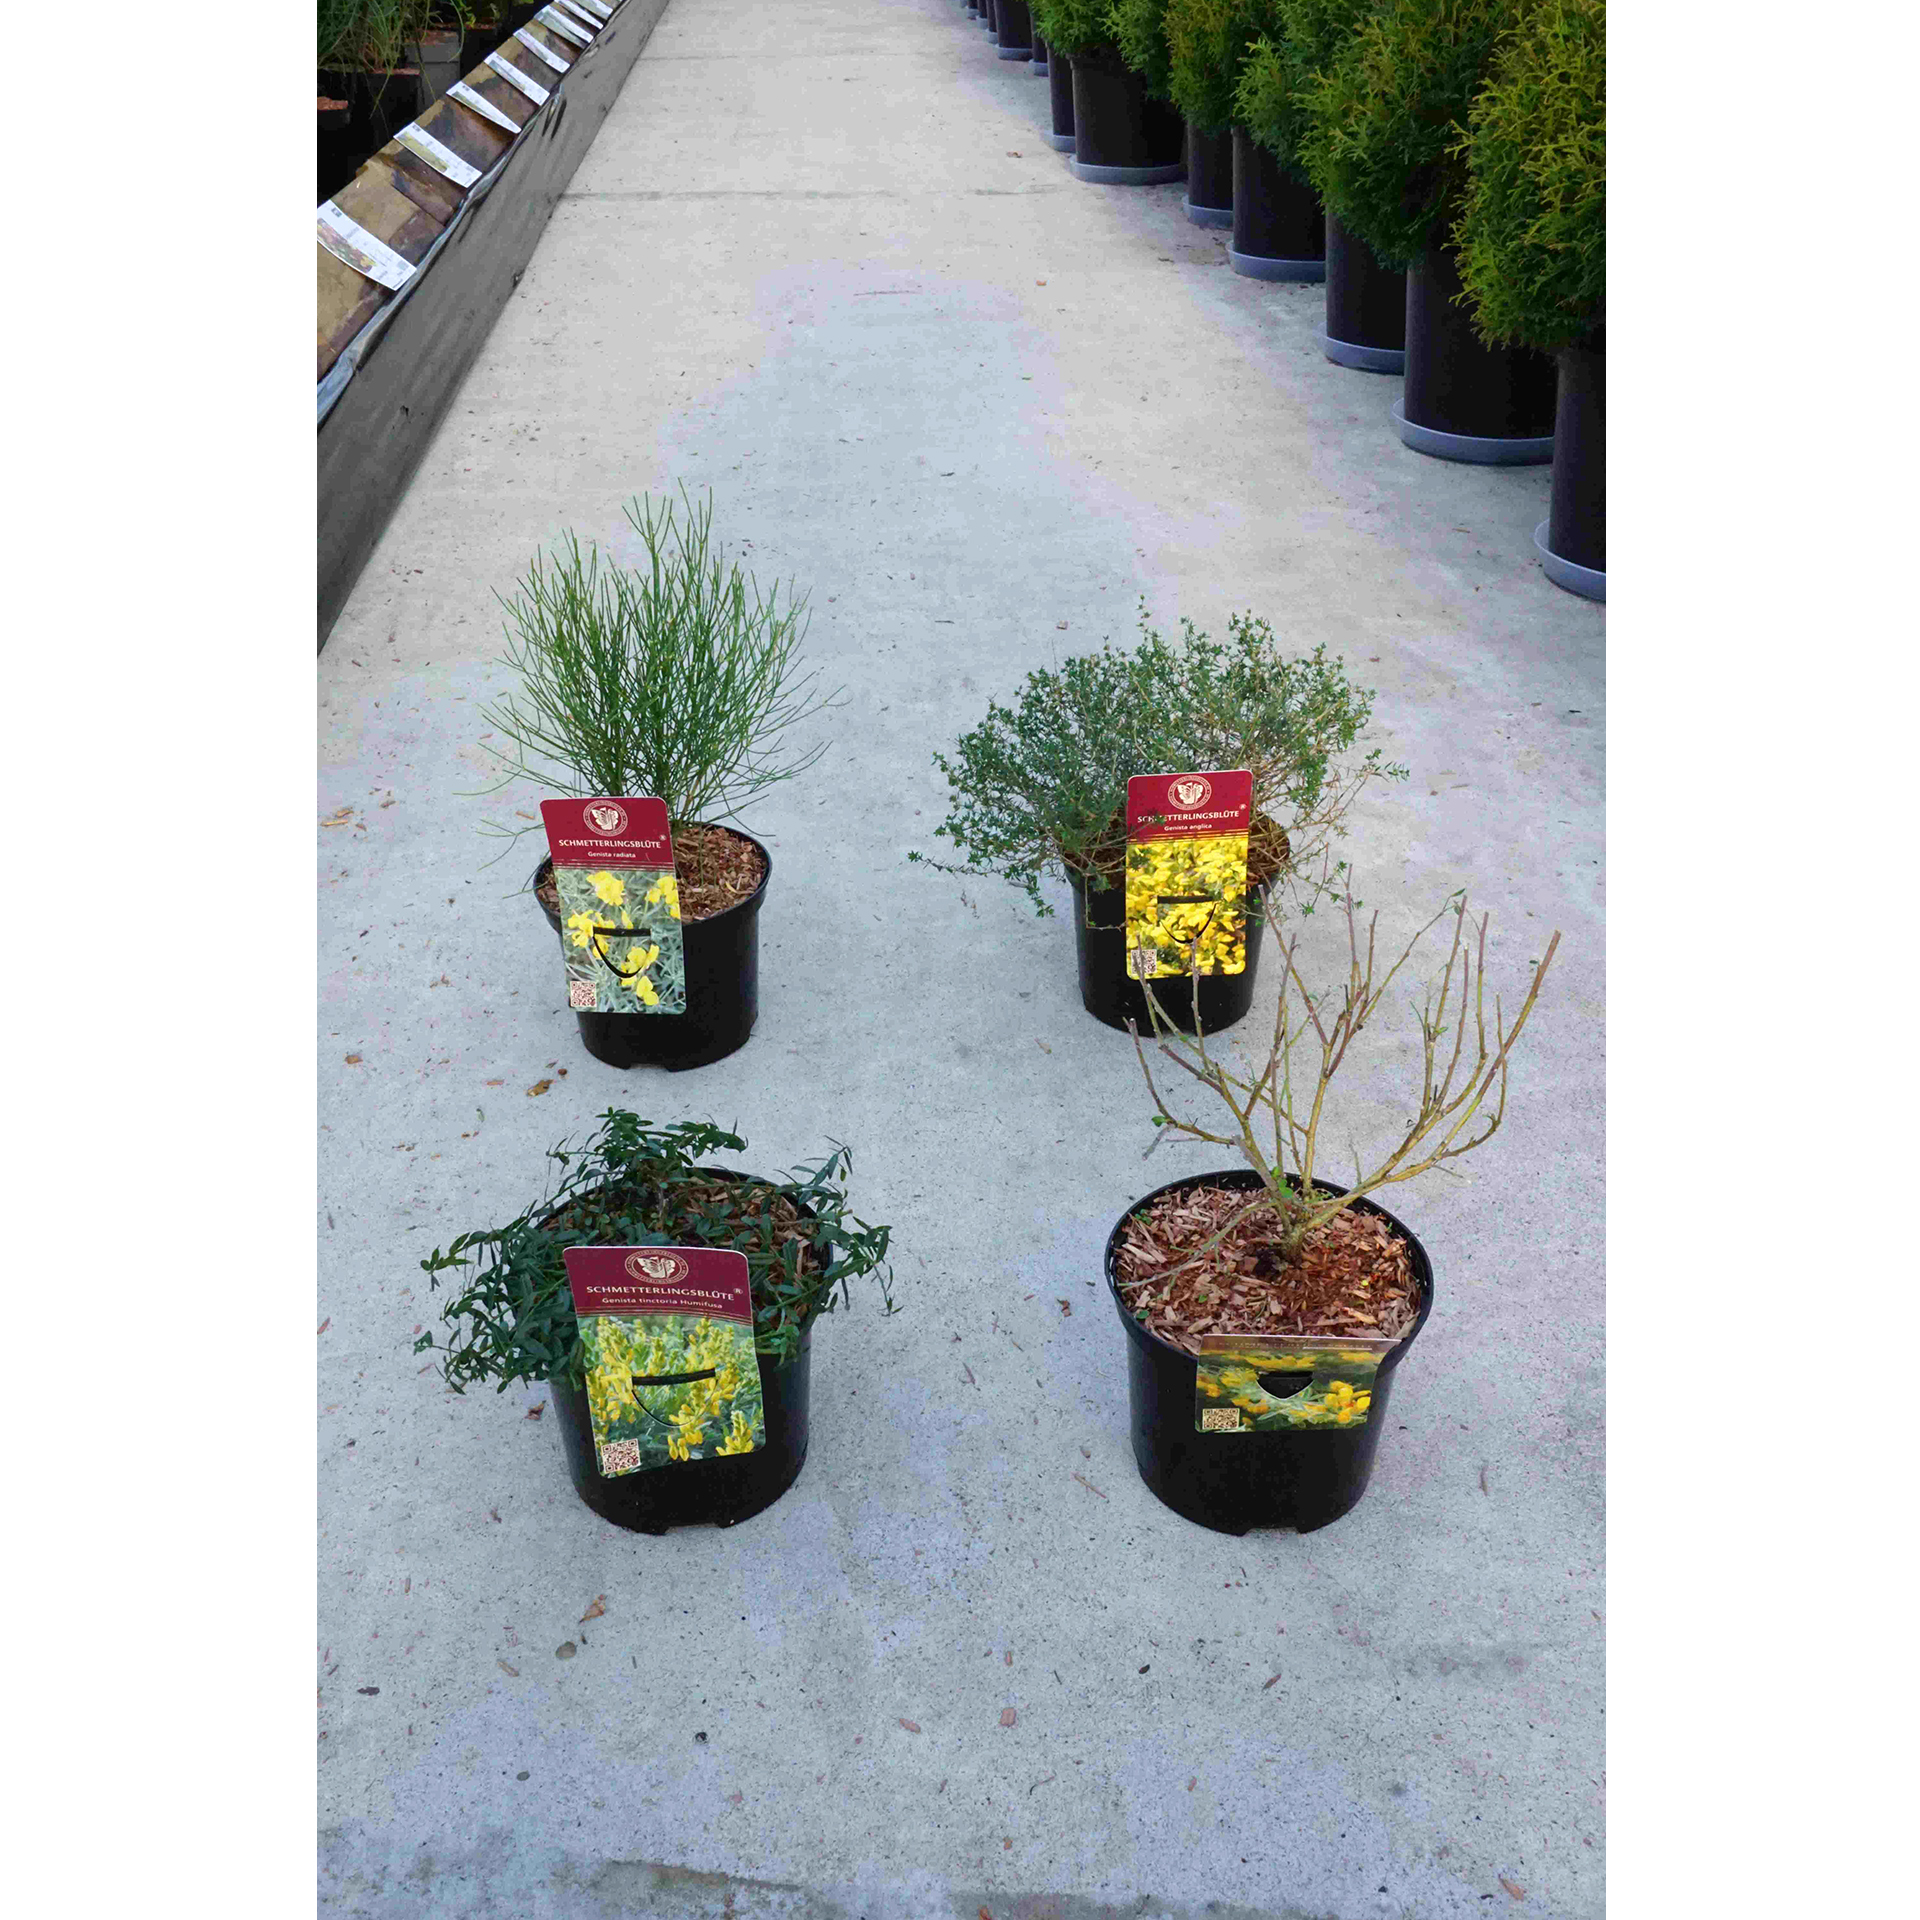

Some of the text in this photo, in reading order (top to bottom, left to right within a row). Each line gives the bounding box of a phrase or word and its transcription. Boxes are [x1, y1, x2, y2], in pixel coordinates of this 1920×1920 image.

[1189, 823, 1213, 831] anglica
[638, 1297, 678, 1305] tinctoria
[680, 1299, 723, 1309] Humifusa
